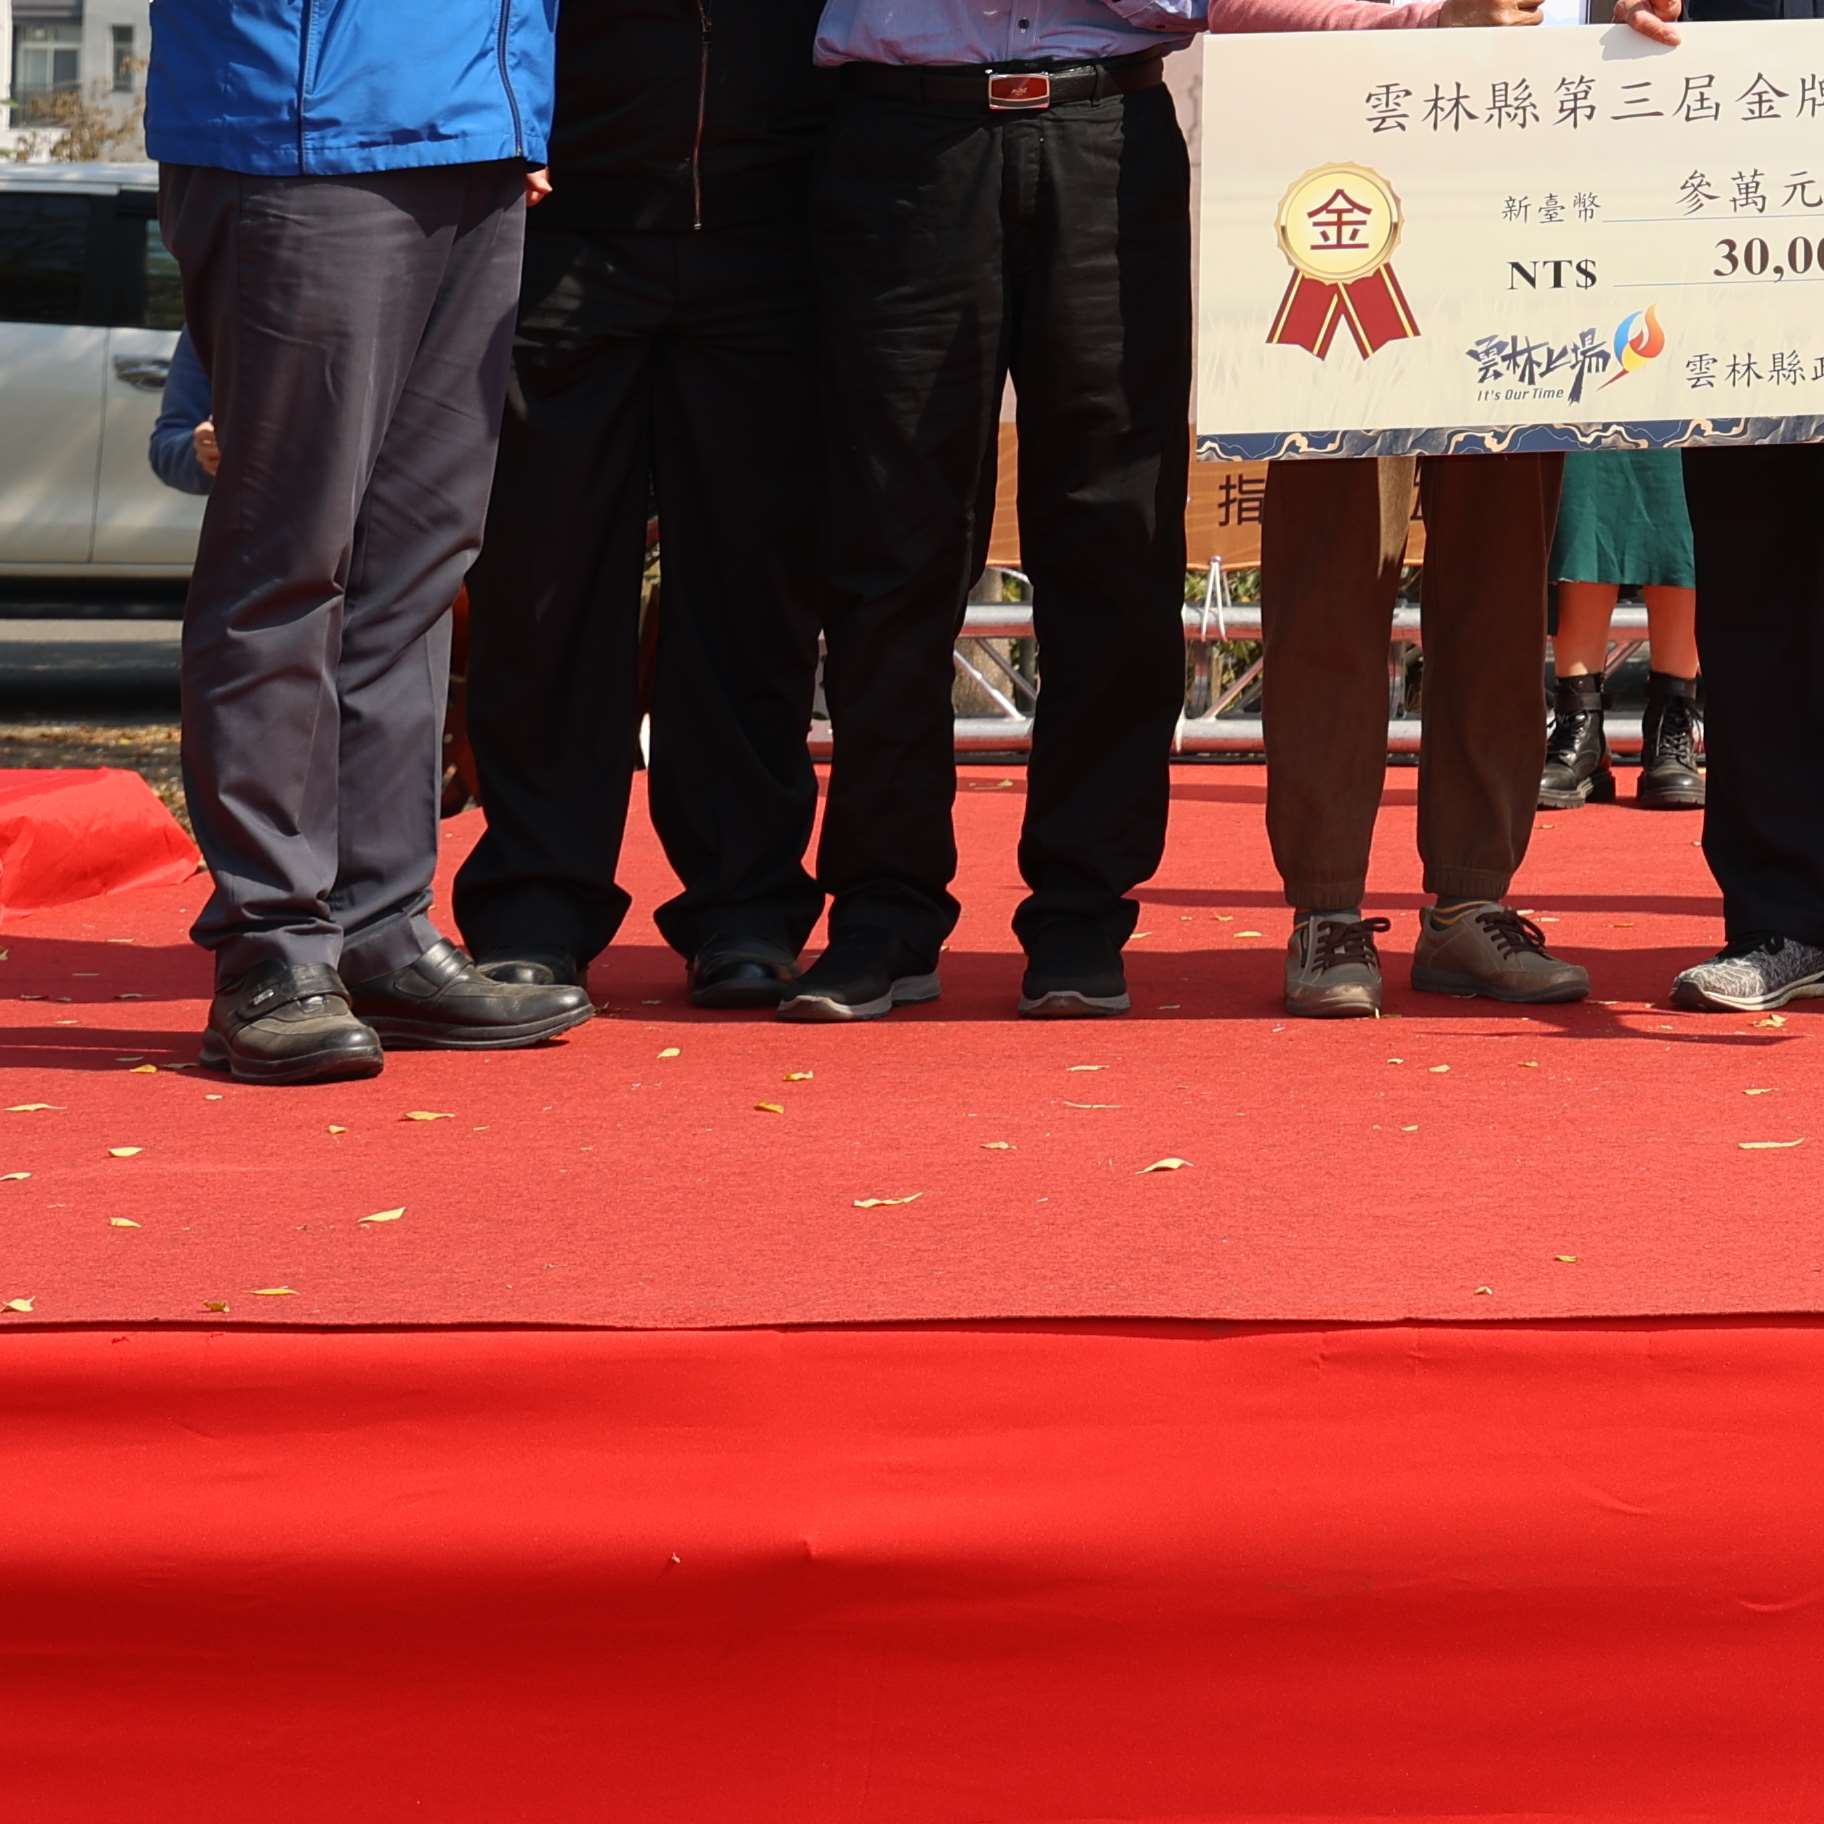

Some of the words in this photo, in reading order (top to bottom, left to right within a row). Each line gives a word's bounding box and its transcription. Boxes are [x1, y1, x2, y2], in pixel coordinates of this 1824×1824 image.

[1307, 188, 1373, 250] 金
[1501, 192, 1601, 224] 新臺幣
[1507, 258, 1598, 290] NT$
[1476, 389, 1501, 403] It's
[1503, 387, 1529, 401] Our
[1531, 386, 1564, 400] Time
